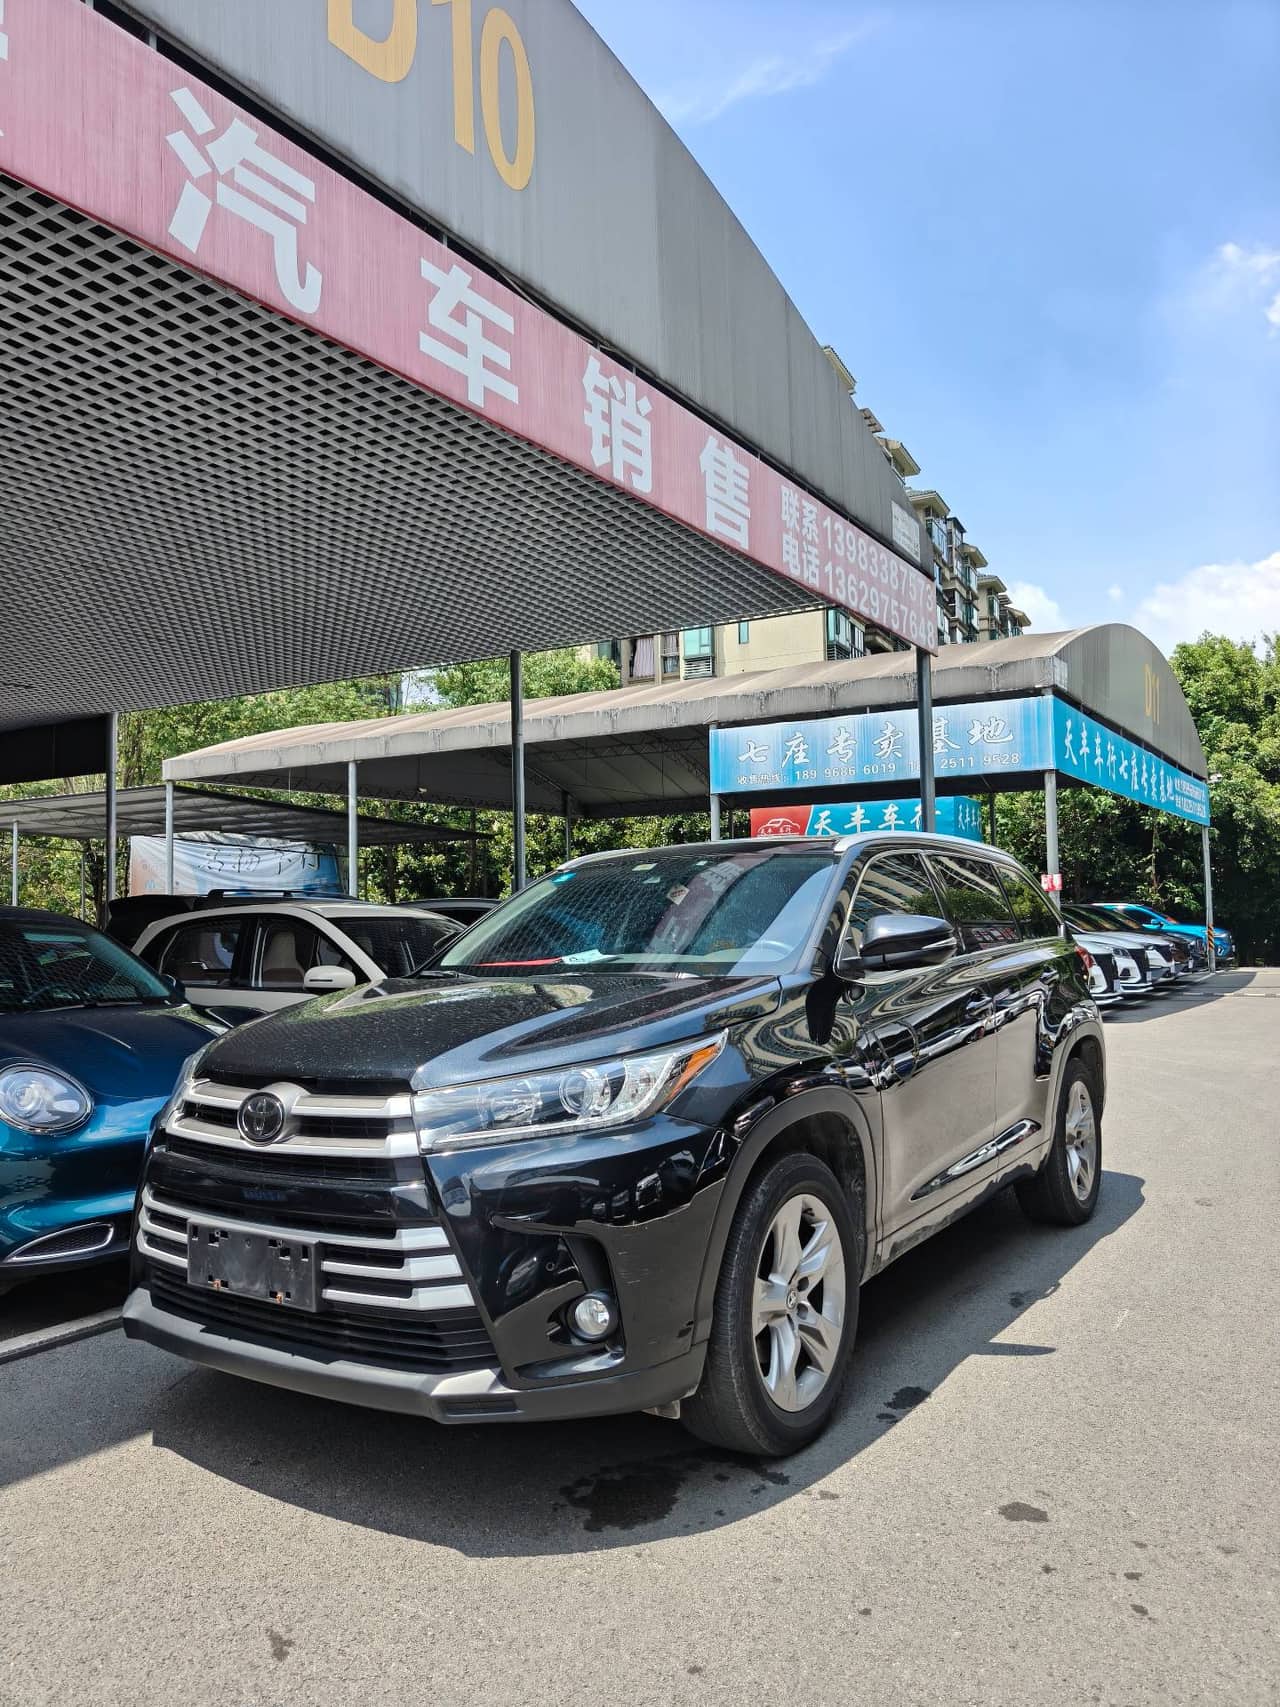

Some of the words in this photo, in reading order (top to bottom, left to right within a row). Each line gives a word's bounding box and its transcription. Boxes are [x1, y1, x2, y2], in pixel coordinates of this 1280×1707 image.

[737, 715, 1014, 769] 七座专卖基地
[795, 770, 817, 781] 189
[863, 763, 896, 775] 6019
[940, 756, 975, 769] 2511
